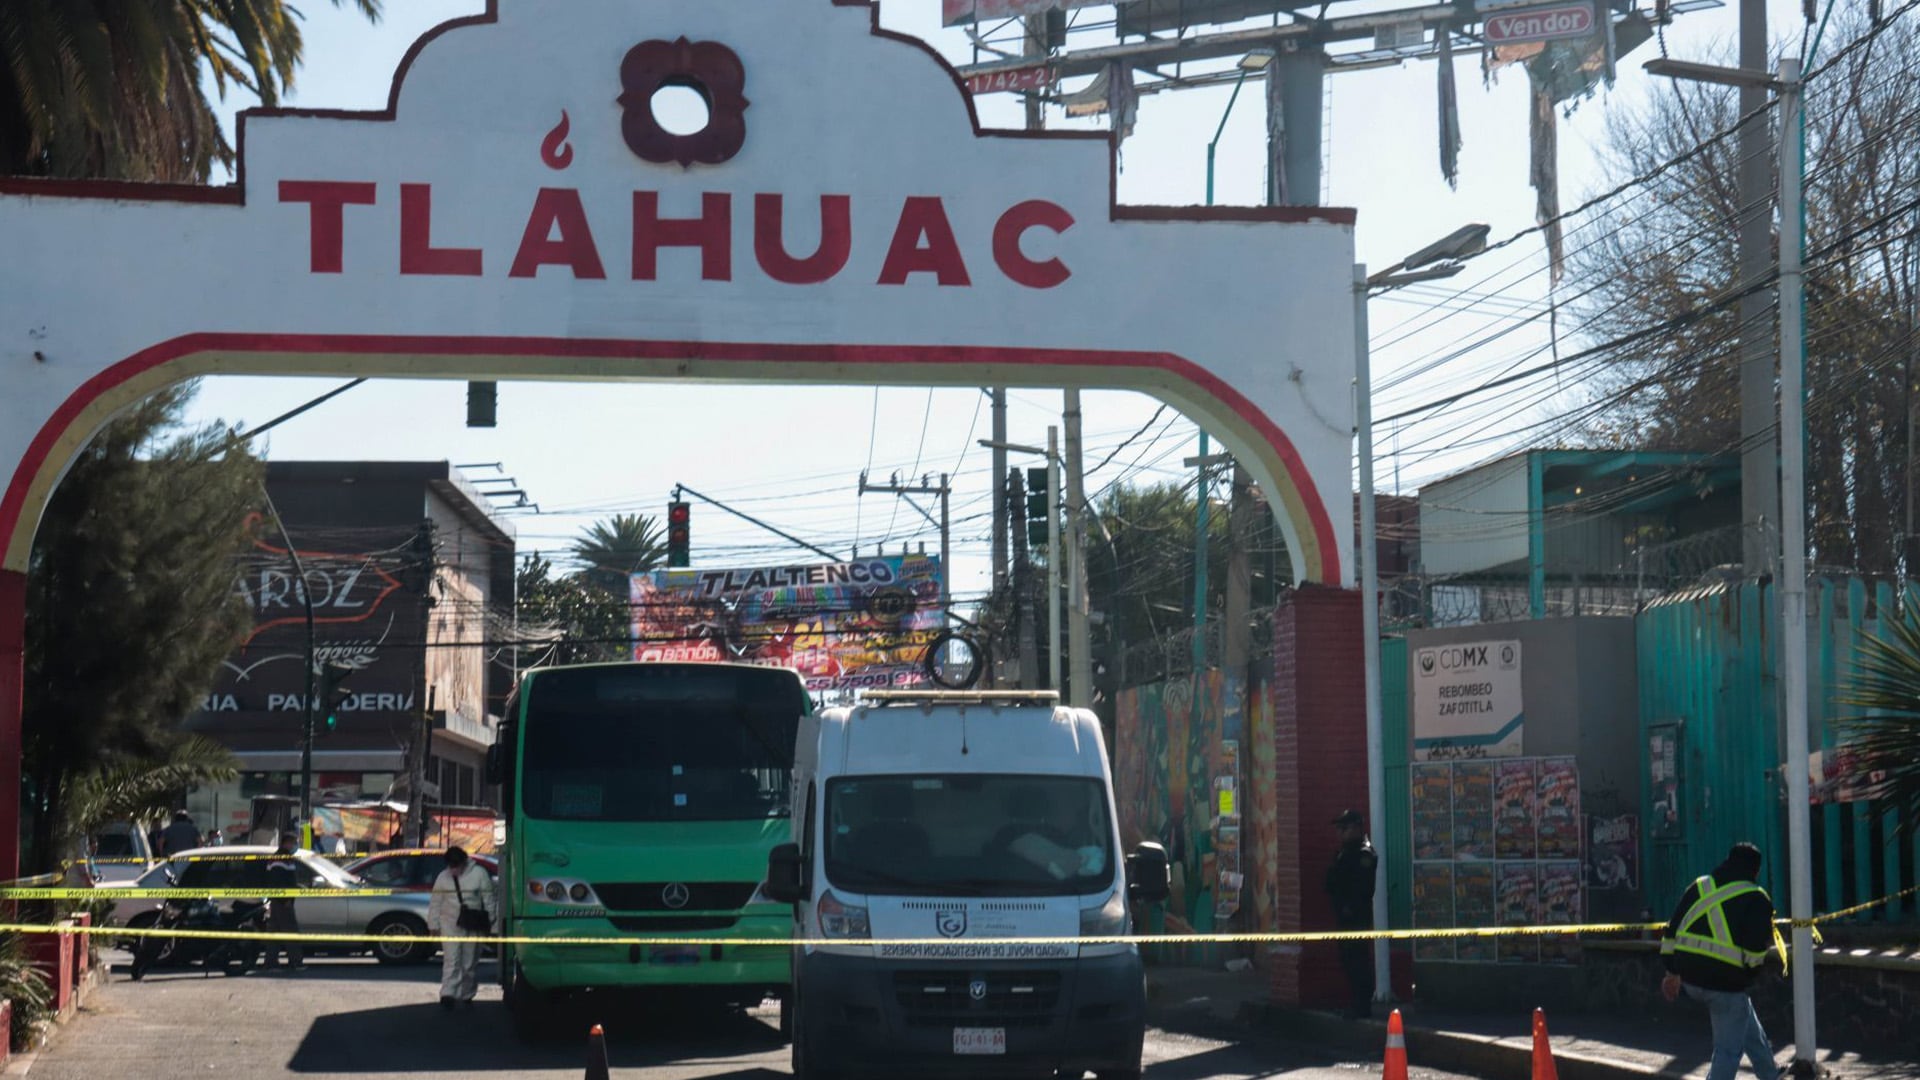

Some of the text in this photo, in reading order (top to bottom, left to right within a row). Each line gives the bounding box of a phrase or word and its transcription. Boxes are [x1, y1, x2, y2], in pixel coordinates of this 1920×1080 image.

[1497, 12, 1582, 38] Vendor
[702, 561, 892, 595] TLALTENCO
[1439, 646, 1489, 670] CDMX
[267, 694, 415, 711] PANDERIA
[1438, 682, 1493, 699] REBOMBEO
